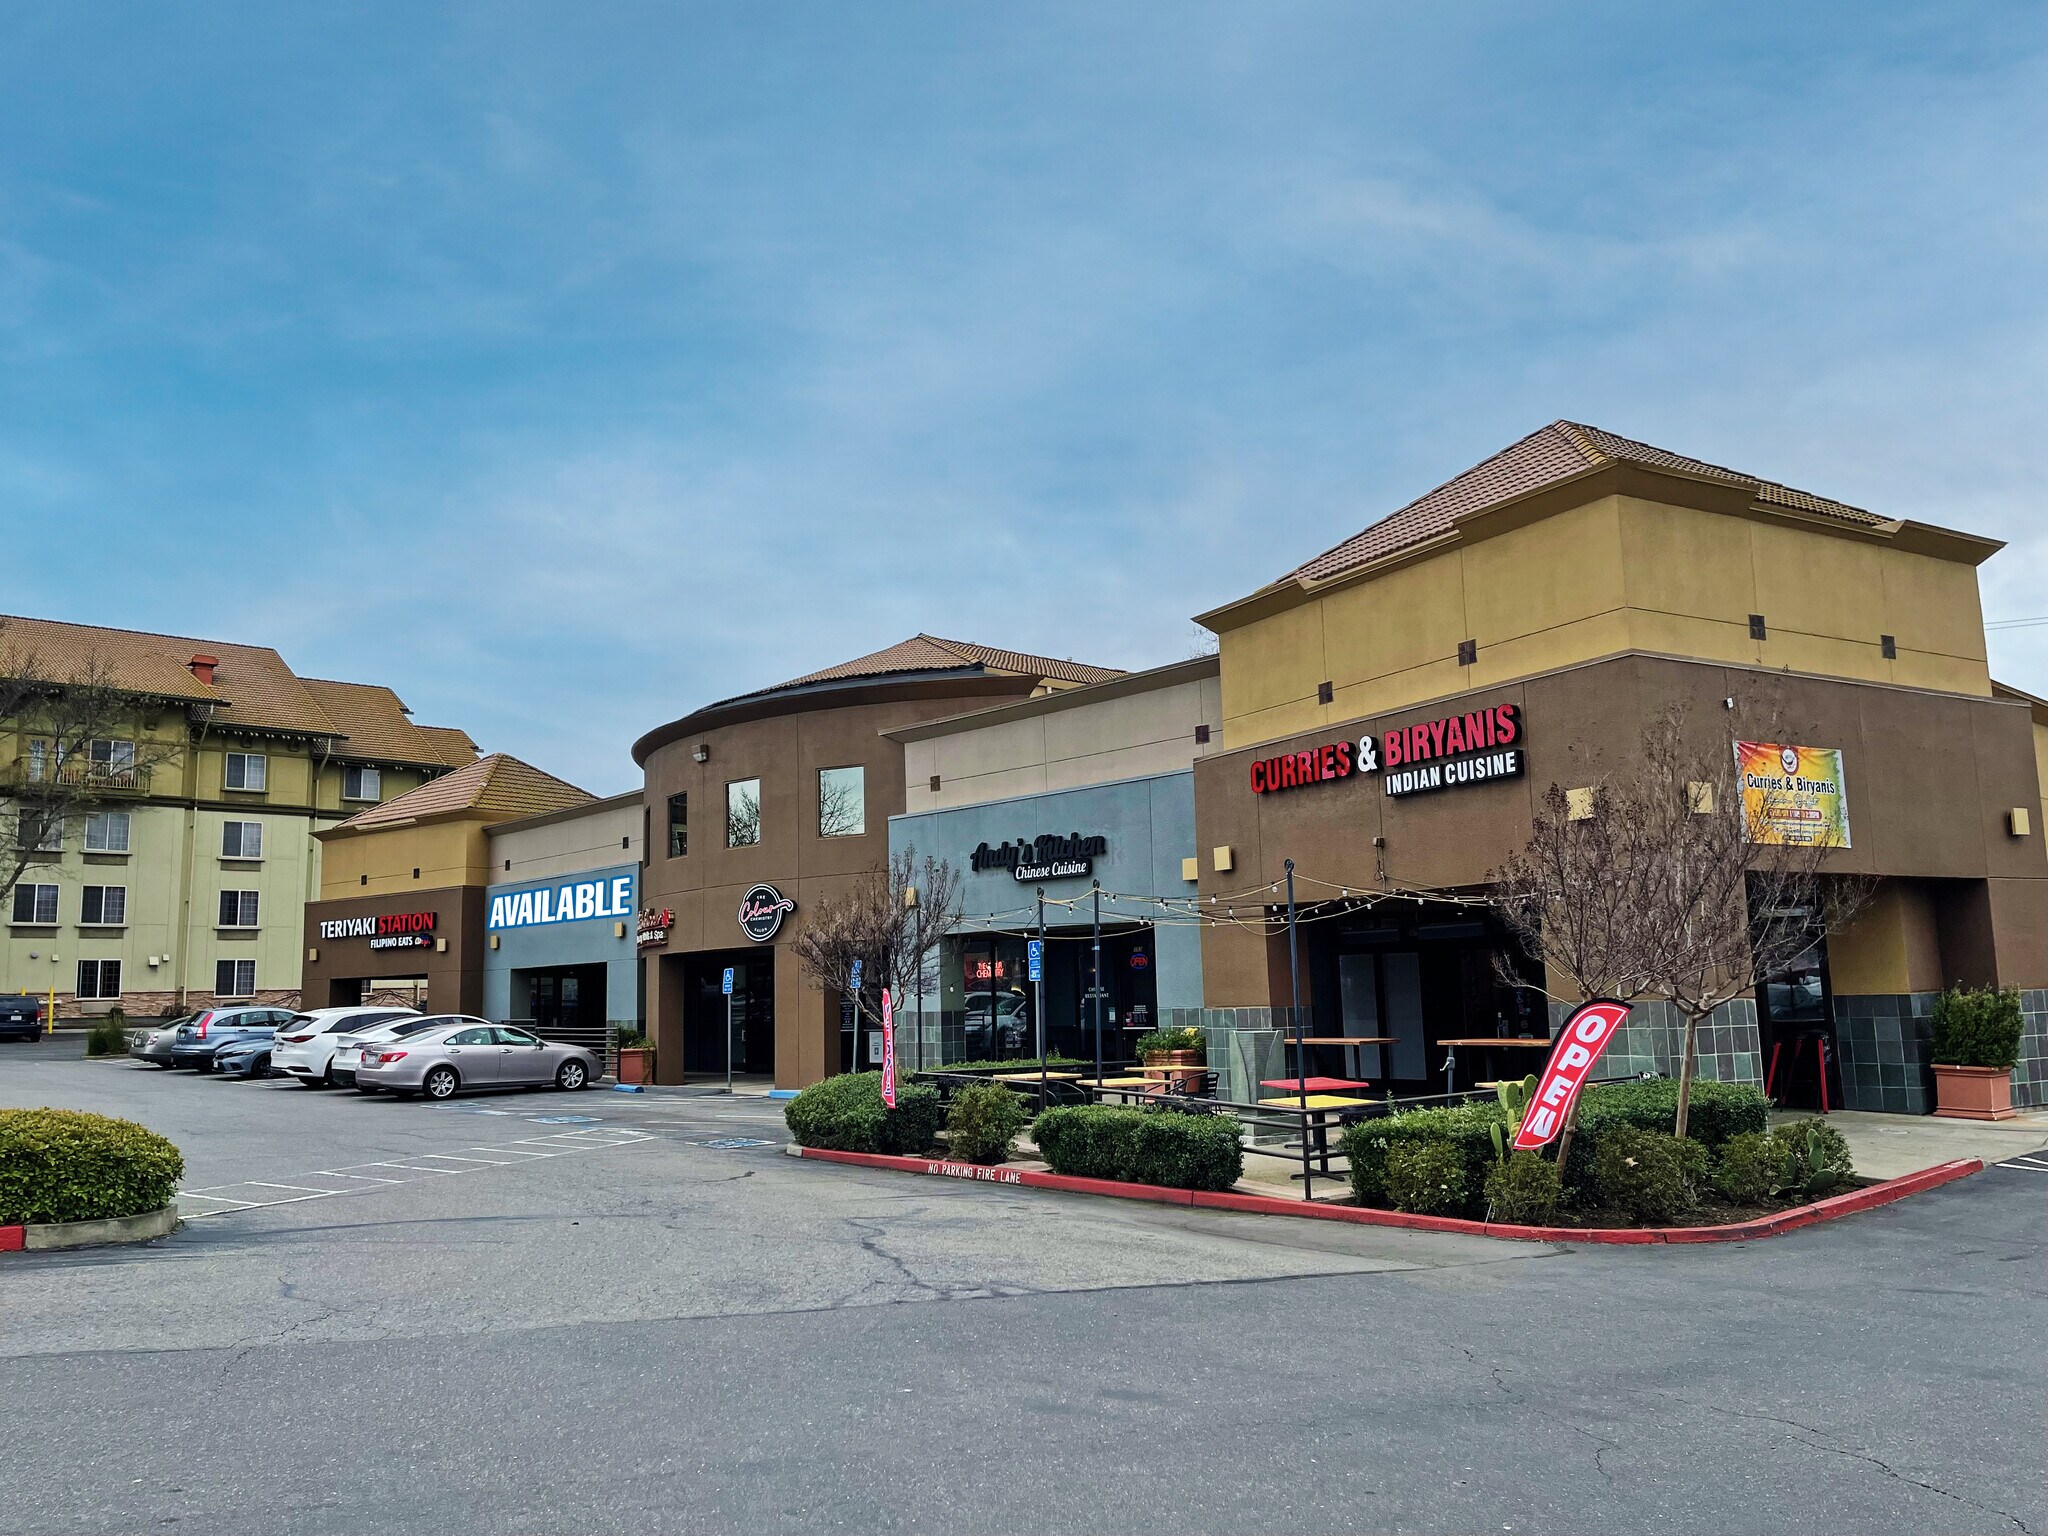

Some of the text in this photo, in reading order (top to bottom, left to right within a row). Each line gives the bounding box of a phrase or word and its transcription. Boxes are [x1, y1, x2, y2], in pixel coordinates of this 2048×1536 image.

[1251, 704, 1516, 794] CURRIES & BIRYANIS
[1386, 751, 1516, 795] INDIAN CUISINE
[1747, 774, 1835, 795] Curries & Biryanis
[969, 832, 1106, 872] Andy's Kitchen
[1015, 861, 1087, 880] Chinese Cuisine
[489, 877, 630, 929] AVAILABLE
[320, 911, 434, 939] TERIYAKI STATION
[370, 937, 397, 949] FILIPINO
[398, 936, 413, 947] EATS
[1526, 1015, 1607, 1139] OPEN
[928, 1163, 1021, 1184] NO PARKING FIRE LANE
